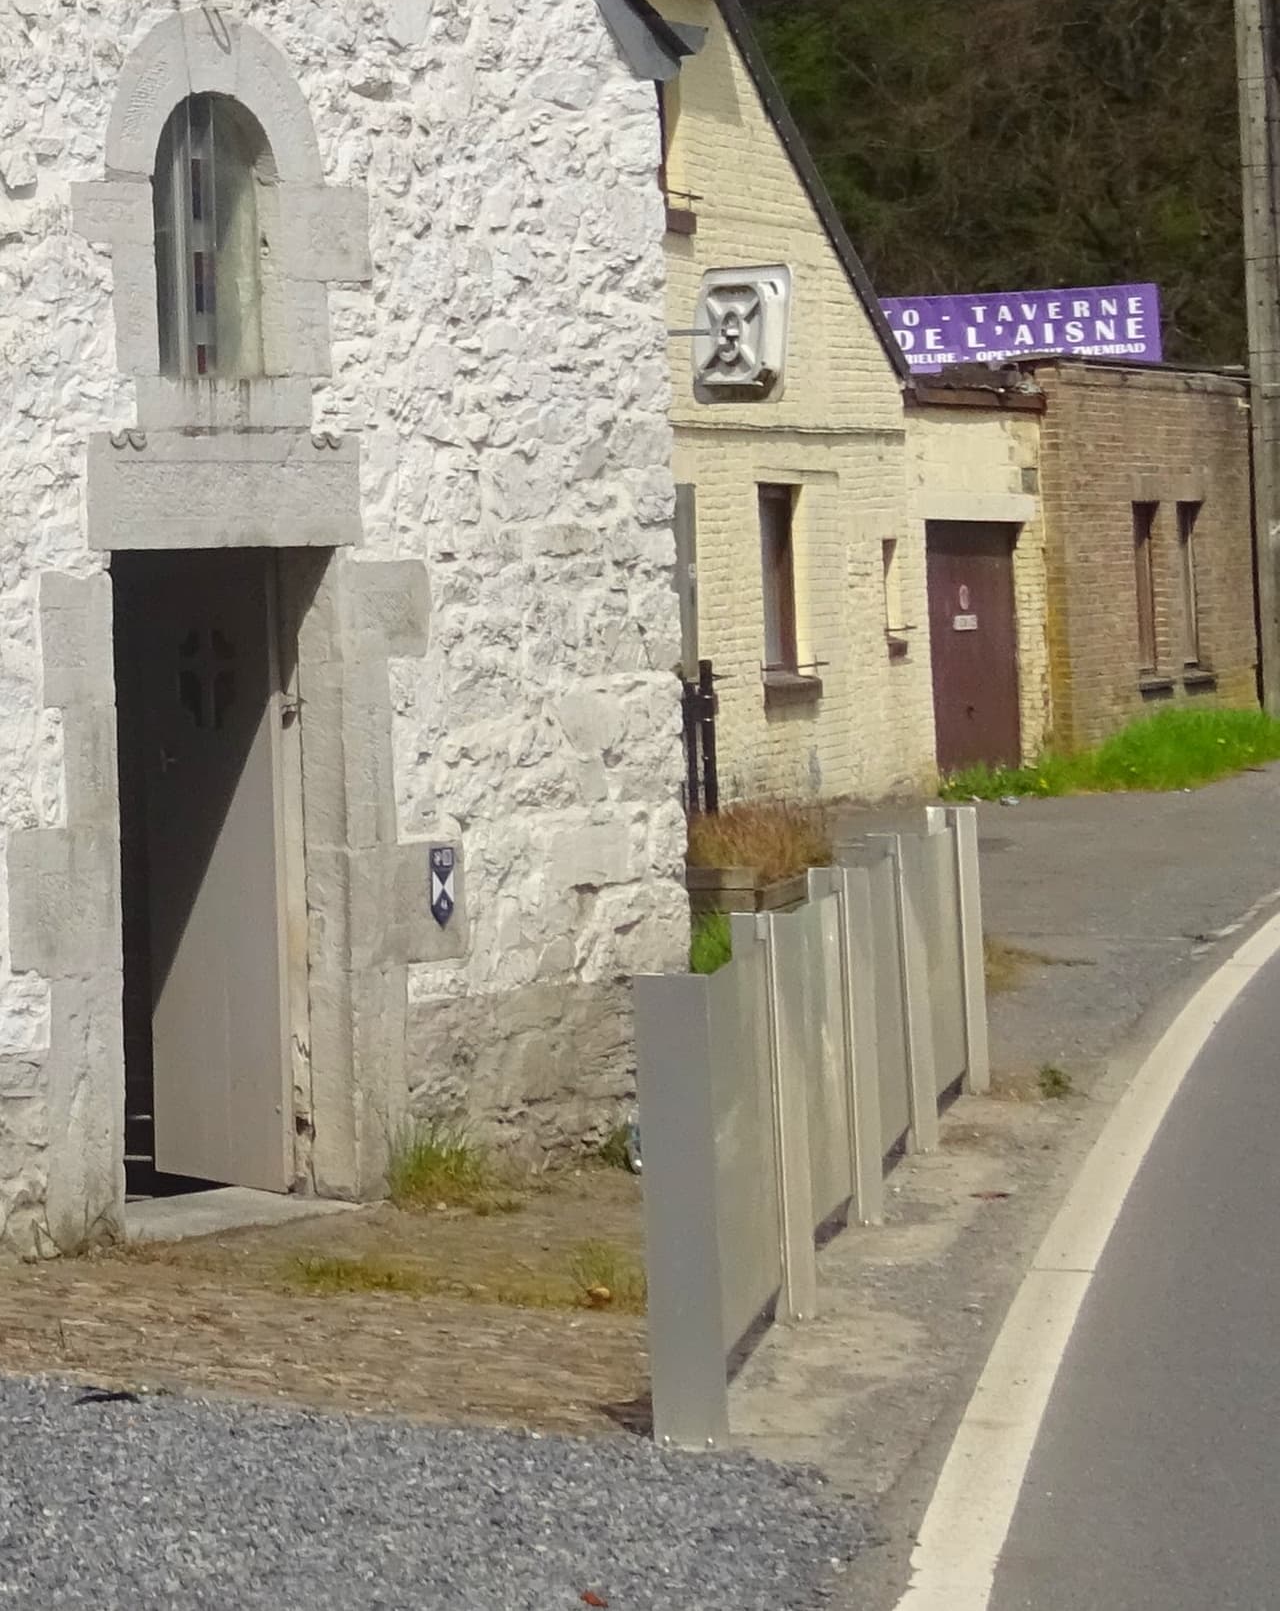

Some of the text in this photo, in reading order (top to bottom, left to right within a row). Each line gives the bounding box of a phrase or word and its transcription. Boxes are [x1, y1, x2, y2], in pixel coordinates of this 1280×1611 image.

[971, 297, 1145, 323] TAVERNE
[893, 318, 1146, 351] DE L'AISNE
